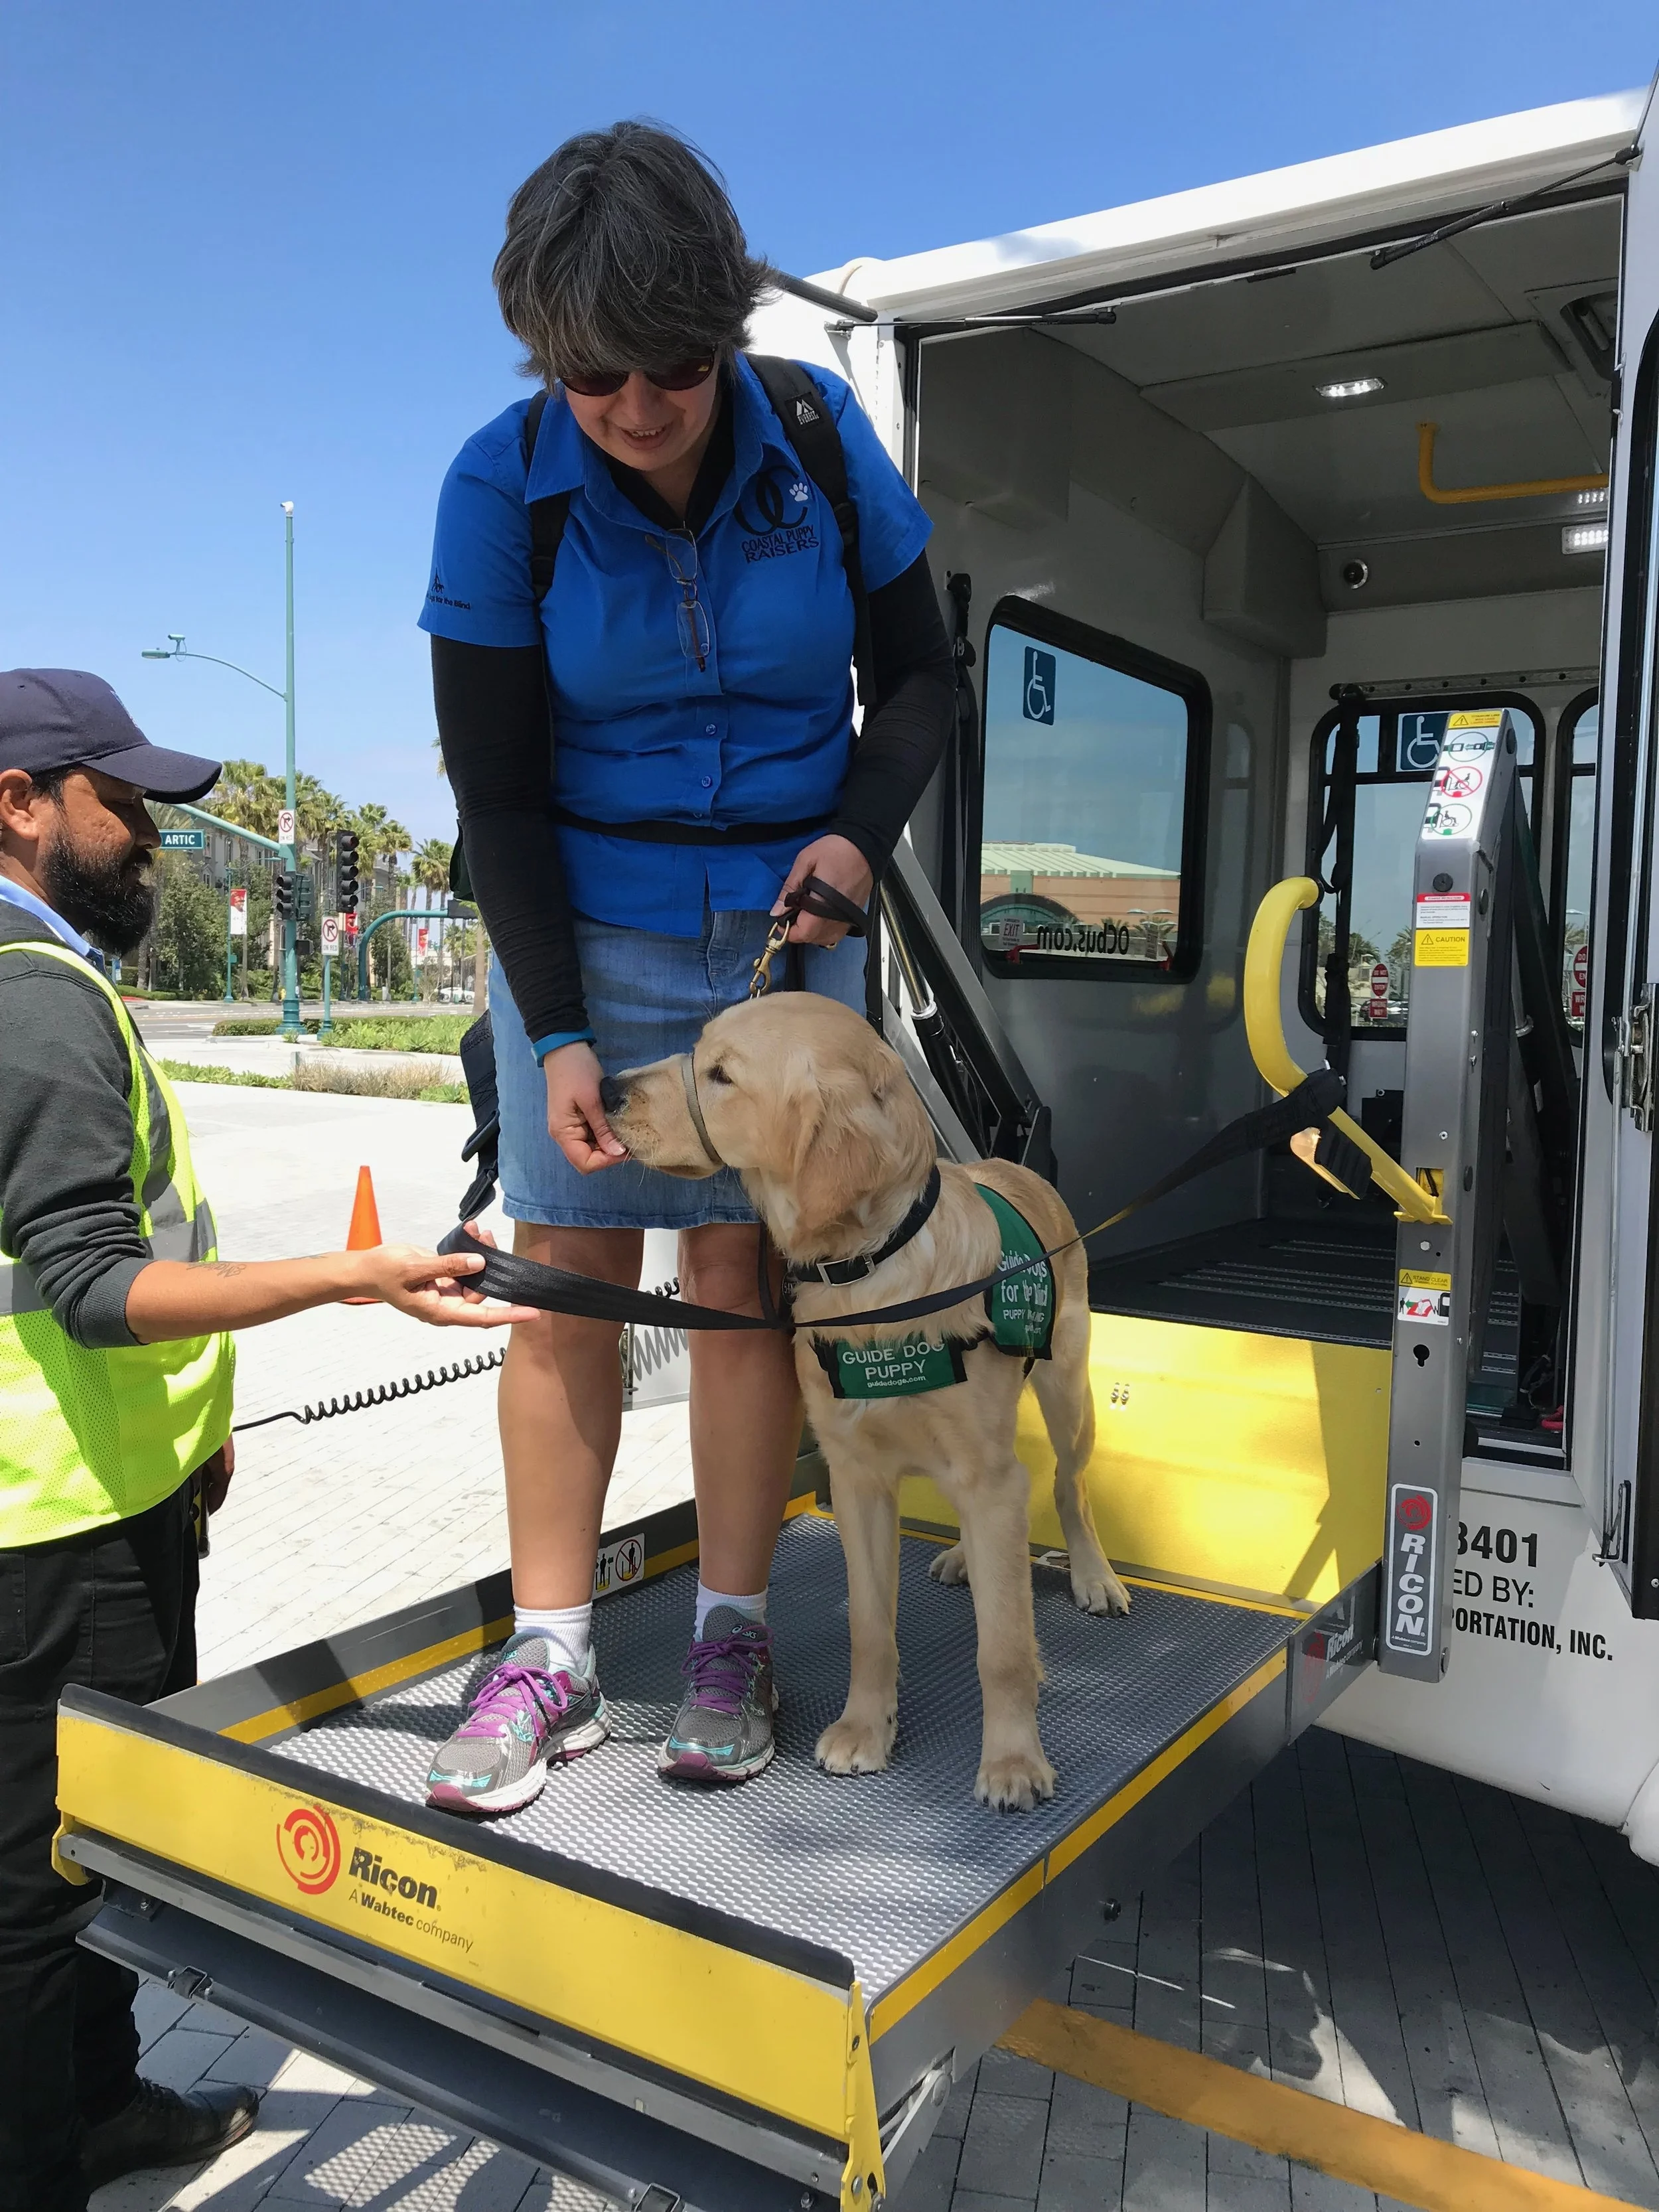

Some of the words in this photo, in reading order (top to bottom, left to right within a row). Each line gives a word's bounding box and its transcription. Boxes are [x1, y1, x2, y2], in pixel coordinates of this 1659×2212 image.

[741, 531, 784, 552] COASTAL
[786, 525, 814, 542] PUPPY
[744, 536, 820, 563] RAISERS
[454, 600, 470, 610] Blind
[165, 834, 195, 845] ARTIC
[1003, 923, 1020, 937] EXIT
[1001, 1280, 1019, 1303] for
[1003, 1309, 1026, 1320] PUPPY
[842, 1349, 895, 1364] GUIDE
[903, 1341, 946, 1359] DOG
[865, 1359, 926, 1380] PUPPY
[1395, 1532, 1426, 1637] RICON
[1493, 1576, 1534, 1608] BY:
[1326, 1624, 1354, 1662] Ricon
[1451, 1607, 1561, 1655] ORTATION,
[1570, 1629, 1613, 1660] INC.
[348, 1846, 438, 1909] Ricon
[349, 1889, 358, 1903] A
[360, 1891, 414, 1926] Wabtec
[416, 1919, 473, 1954] company
